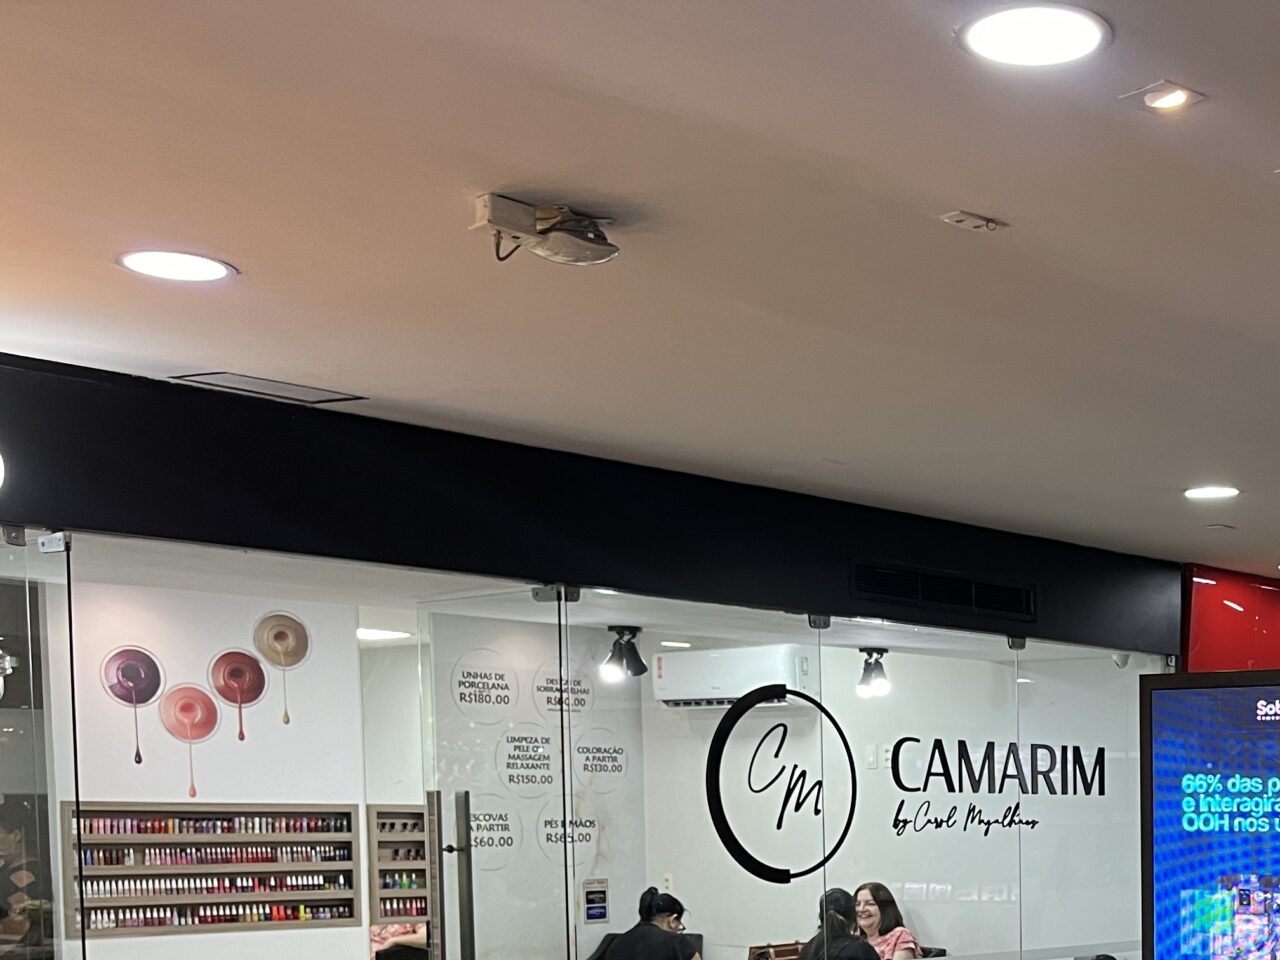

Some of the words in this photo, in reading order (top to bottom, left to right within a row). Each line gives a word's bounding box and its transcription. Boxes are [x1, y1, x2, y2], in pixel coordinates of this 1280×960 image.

[462, 671, 493, 681] UNHAS
[494, 672, 505, 682] DE
[458, 680, 510, 691] PORCELANA
[506, 736, 540, 745] LIMPEZA
[541, 737, 551, 745] DE
[513, 744, 530, 753] PELE
[577, 746, 624, 756] COLORAÇÃO
[508, 753, 551, 762] MASSAGEM
[585, 755, 591, 763] A
[506, 762, 551, 771] RELAXANTE
[890, 736, 1106, 796] CAMARIM
[1181, 774, 1223, 794] 66%
[1227, 774, 1263, 793] das
[1182, 796, 1196, 812] e
[544, 818, 559, 829] PÉS
[1182, 812, 1230, 832] OOH
[1234, 816, 1270, 832] nos
[476, 823, 510, 832] PARTIR
